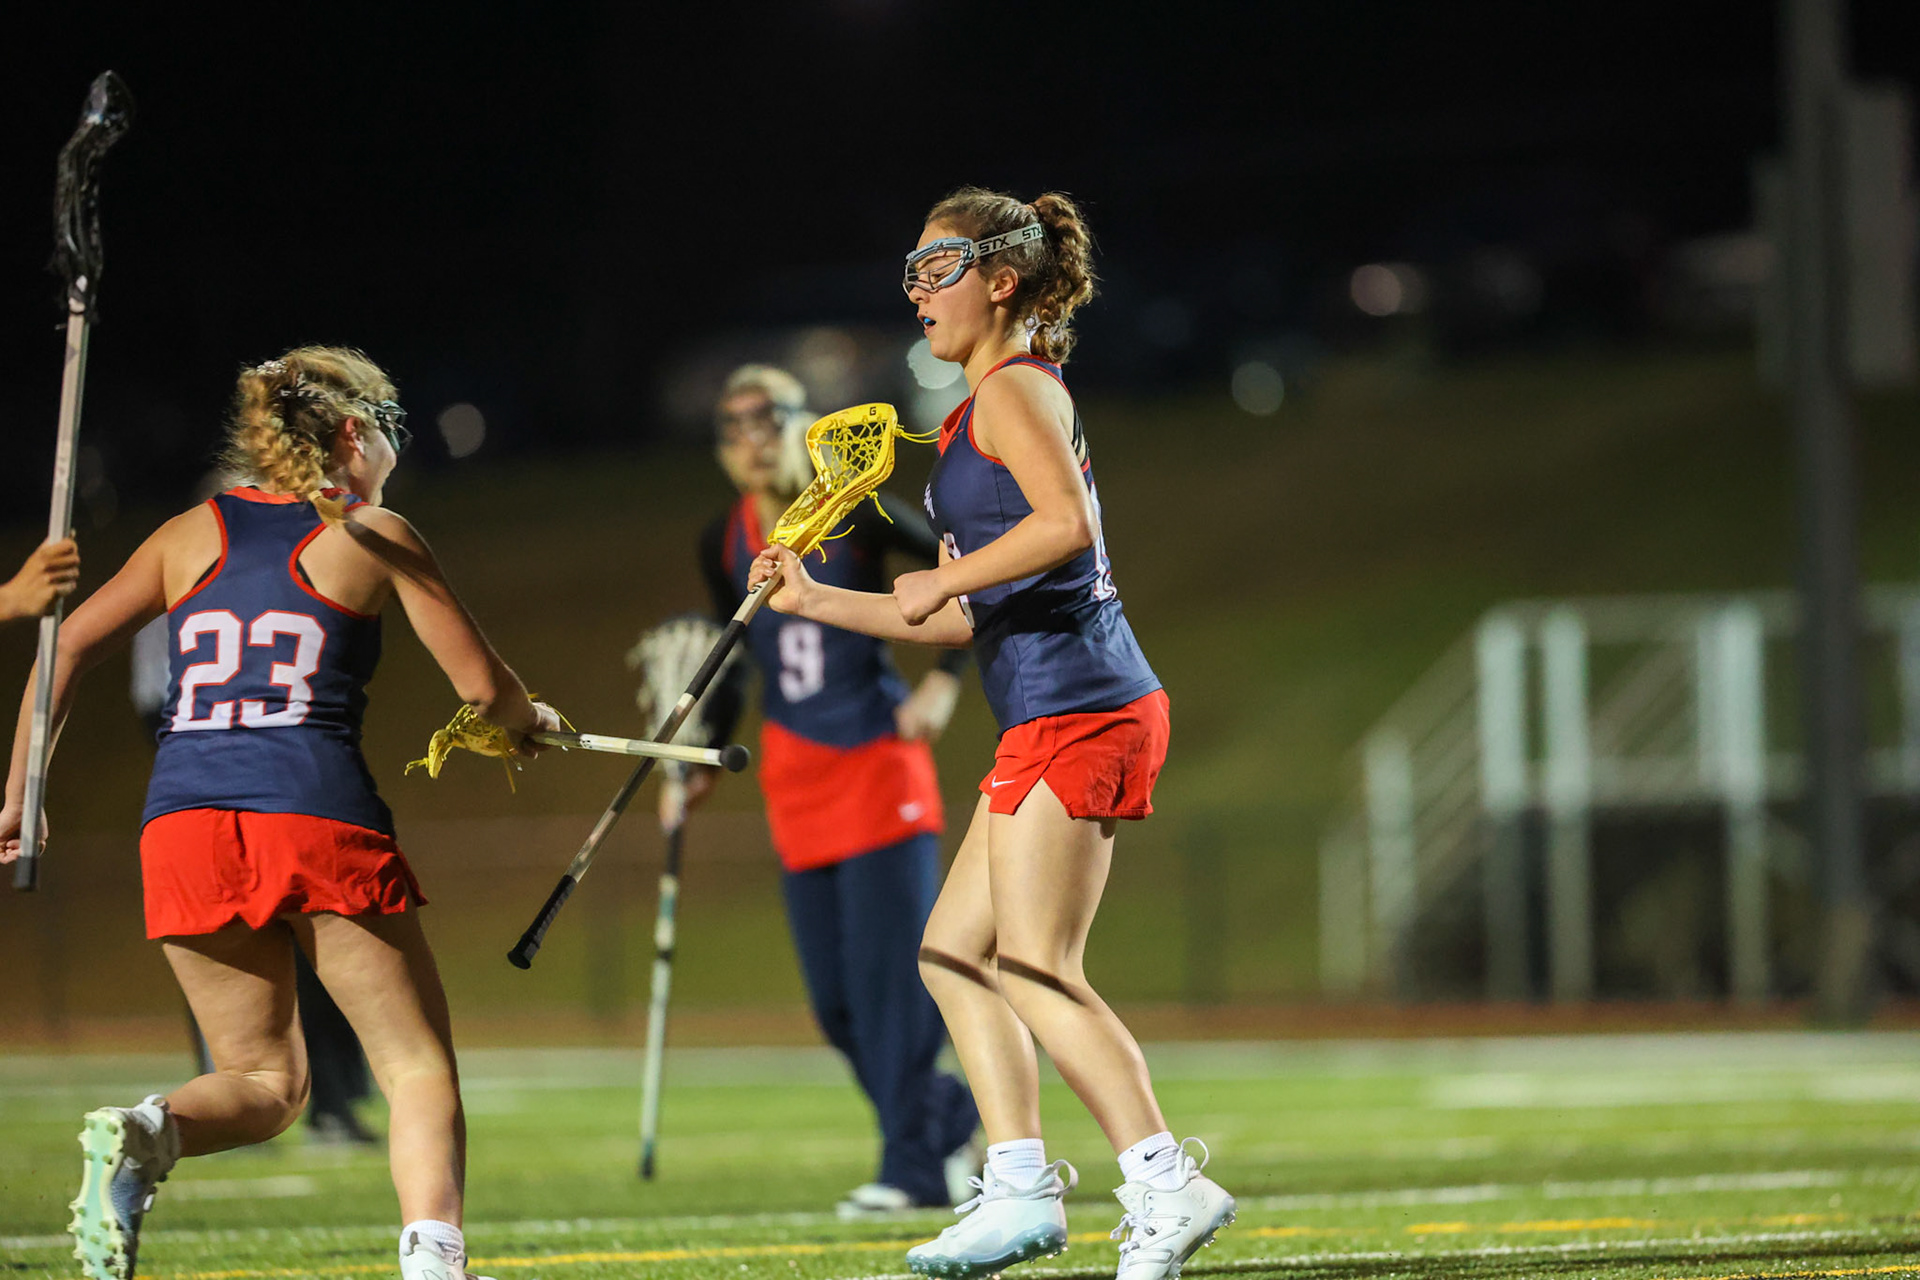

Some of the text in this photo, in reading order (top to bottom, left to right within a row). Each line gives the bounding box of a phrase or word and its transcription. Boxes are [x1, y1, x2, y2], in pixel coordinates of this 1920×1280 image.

[979, 226, 1043, 254] STX STX
[171, 609, 327, 732] 23
[778, 621, 825, 703] 9
